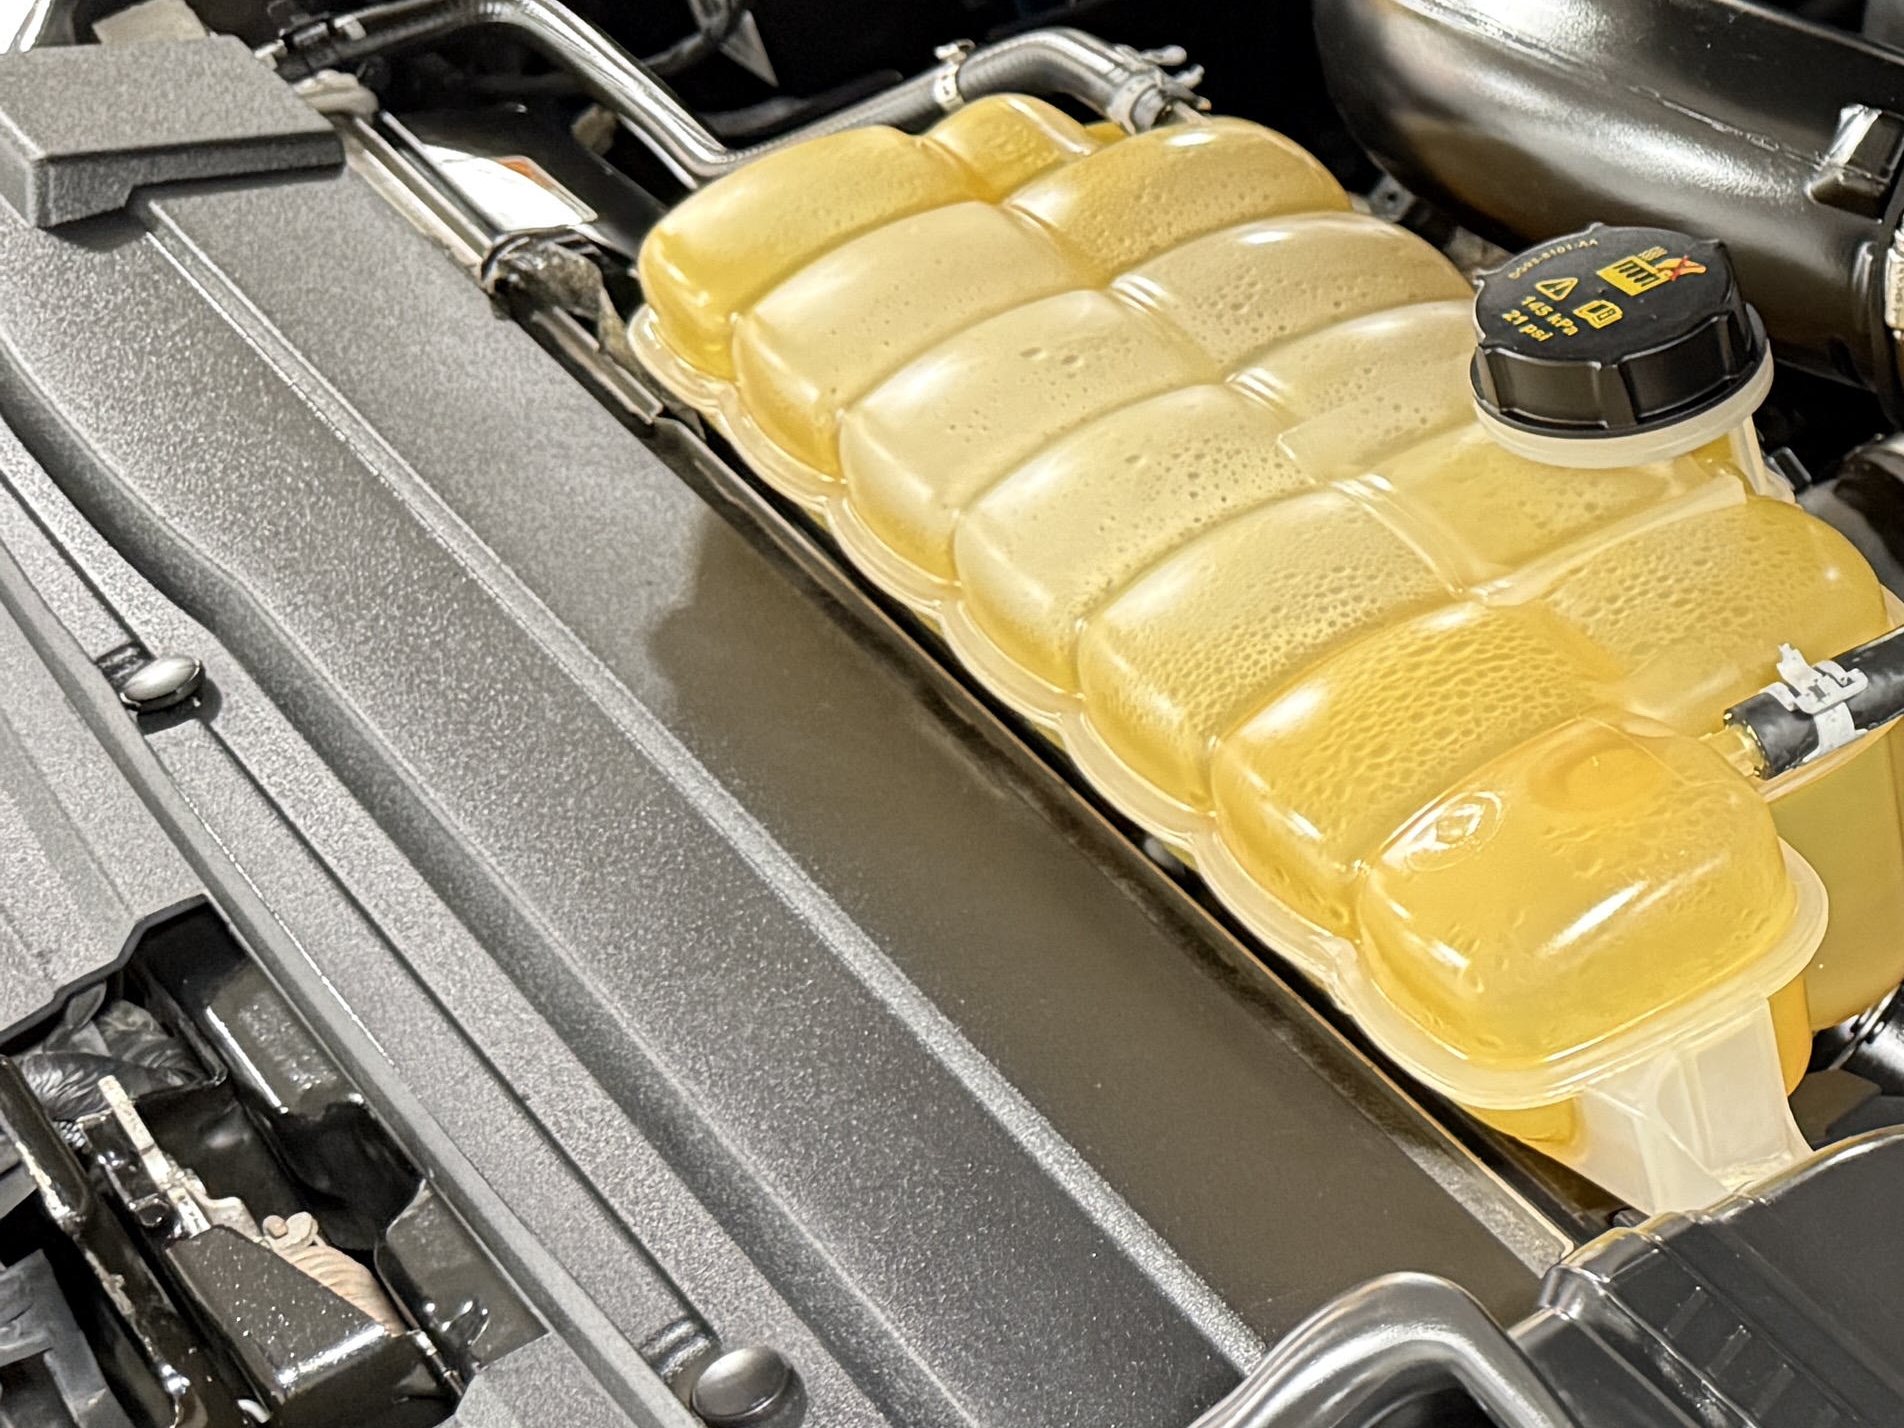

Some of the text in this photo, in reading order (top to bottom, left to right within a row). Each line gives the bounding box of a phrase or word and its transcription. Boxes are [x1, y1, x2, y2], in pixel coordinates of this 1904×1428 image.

[1501, 309, 1554, 342] 21 psi
[1521, 296, 1579, 337] 145 kPa
